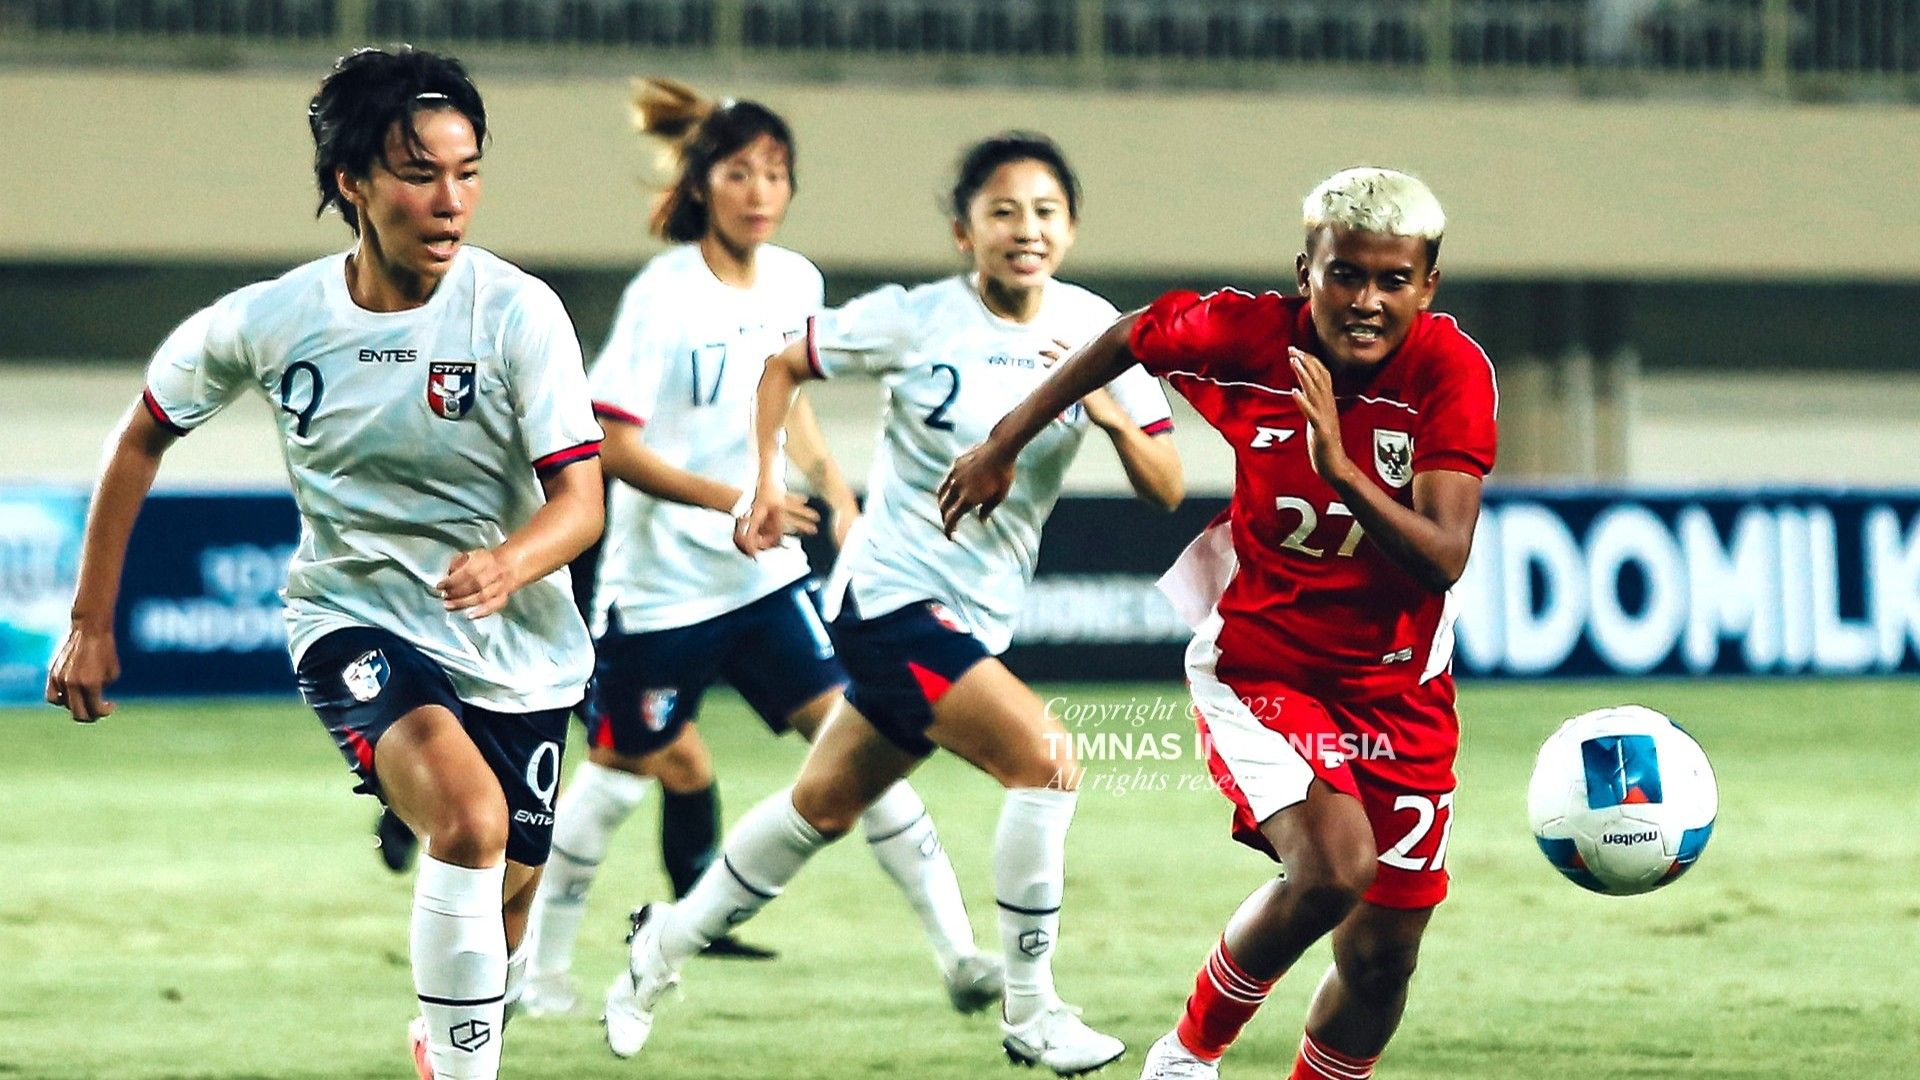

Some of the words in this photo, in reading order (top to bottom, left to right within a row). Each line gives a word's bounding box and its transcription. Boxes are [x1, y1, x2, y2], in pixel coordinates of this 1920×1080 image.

[359, 349, 417, 362] ENTES
[692, 343, 727, 407] 17
[281, 360, 325, 438] 9
[924, 363, 961, 432] 2
[1275, 496, 1365, 558] 27
[1602, 831, 1657, 846] molten
